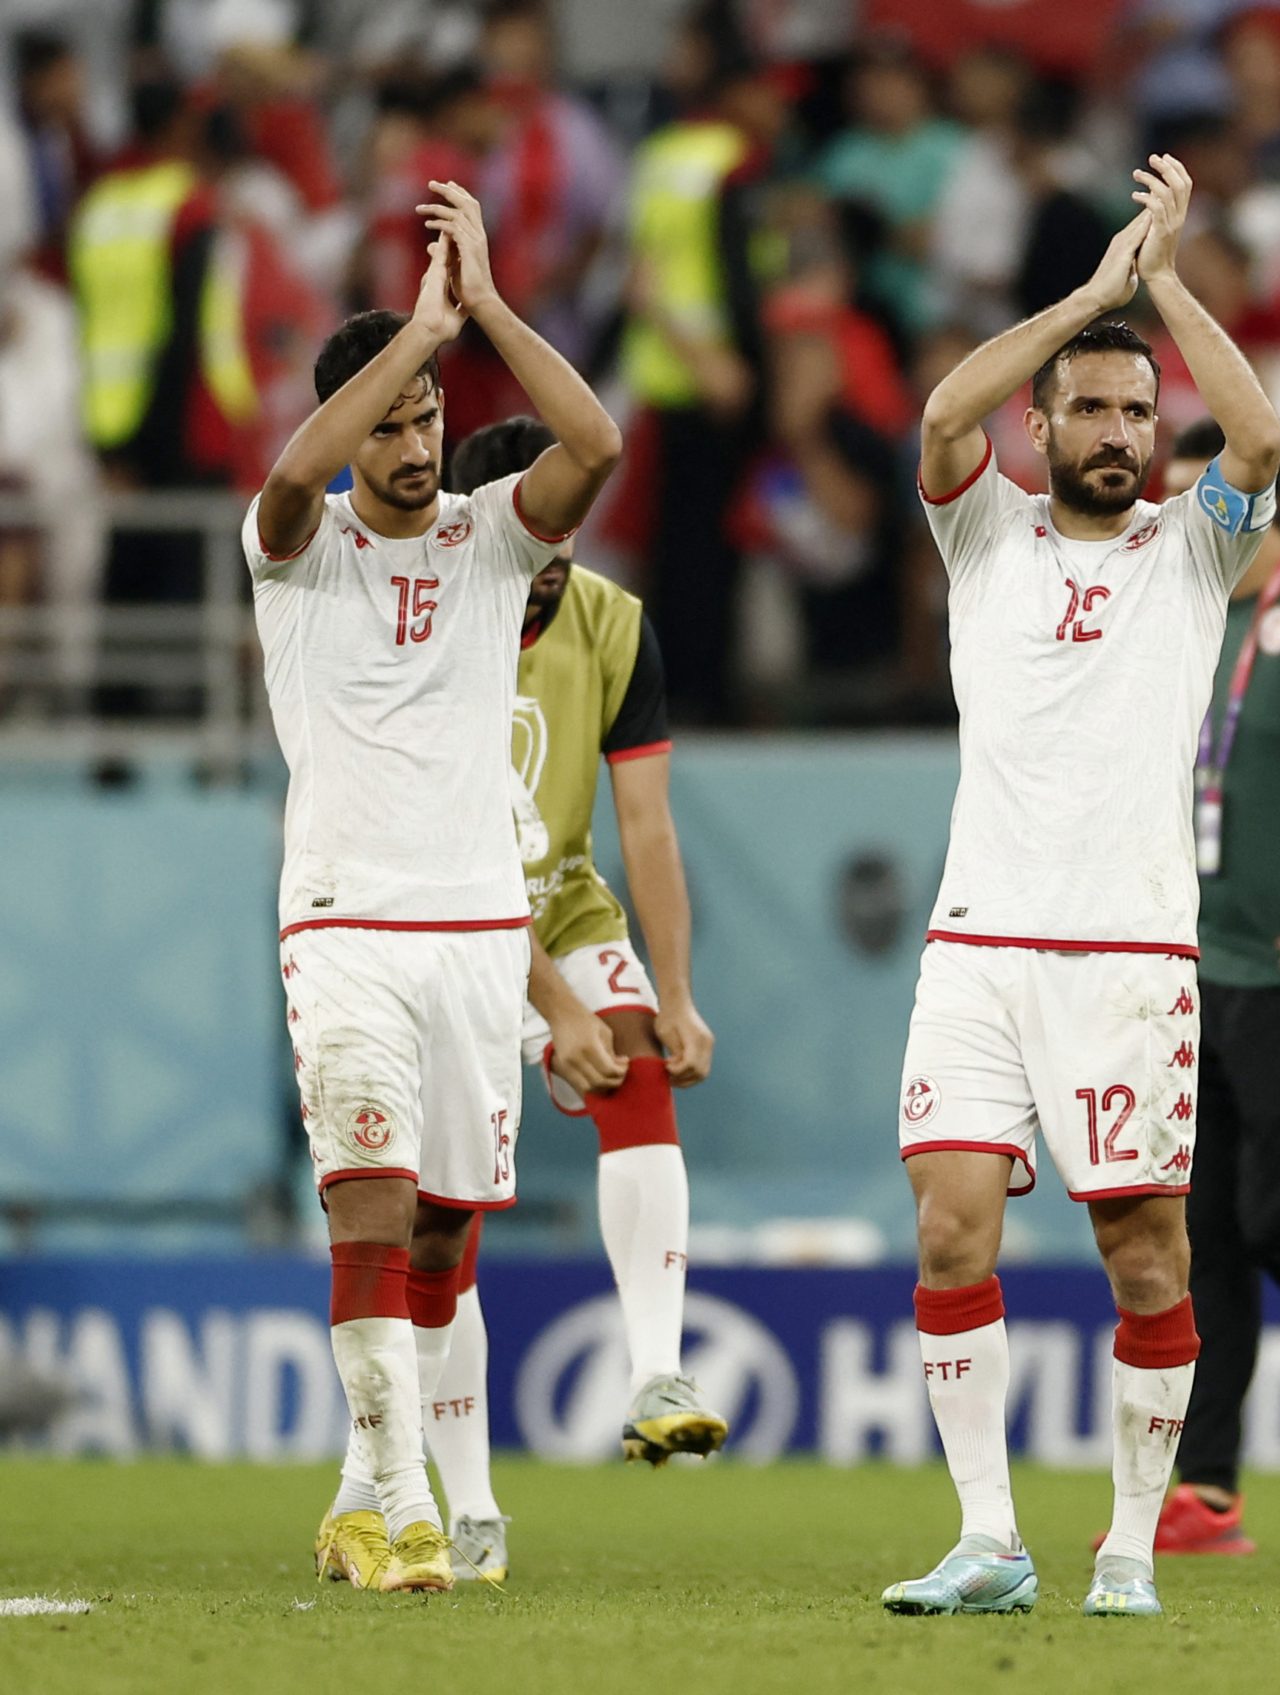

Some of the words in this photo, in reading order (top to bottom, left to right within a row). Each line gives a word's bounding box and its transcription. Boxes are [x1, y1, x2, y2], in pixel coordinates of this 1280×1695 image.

[391, 575, 440, 646] 15
[1056, 578, 1111, 642] 12
[598, 950, 640, 994] 2
[491, 1109, 509, 1184] 15
[1075, 1084, 1138, 1165] 12
[664, 1250, 687, 1271] FT
[923, 1359, 972, 1380] FTF
[433, 1397, 475, 1420] FTF
[1148, 1416, 1185, 1438] FTF
